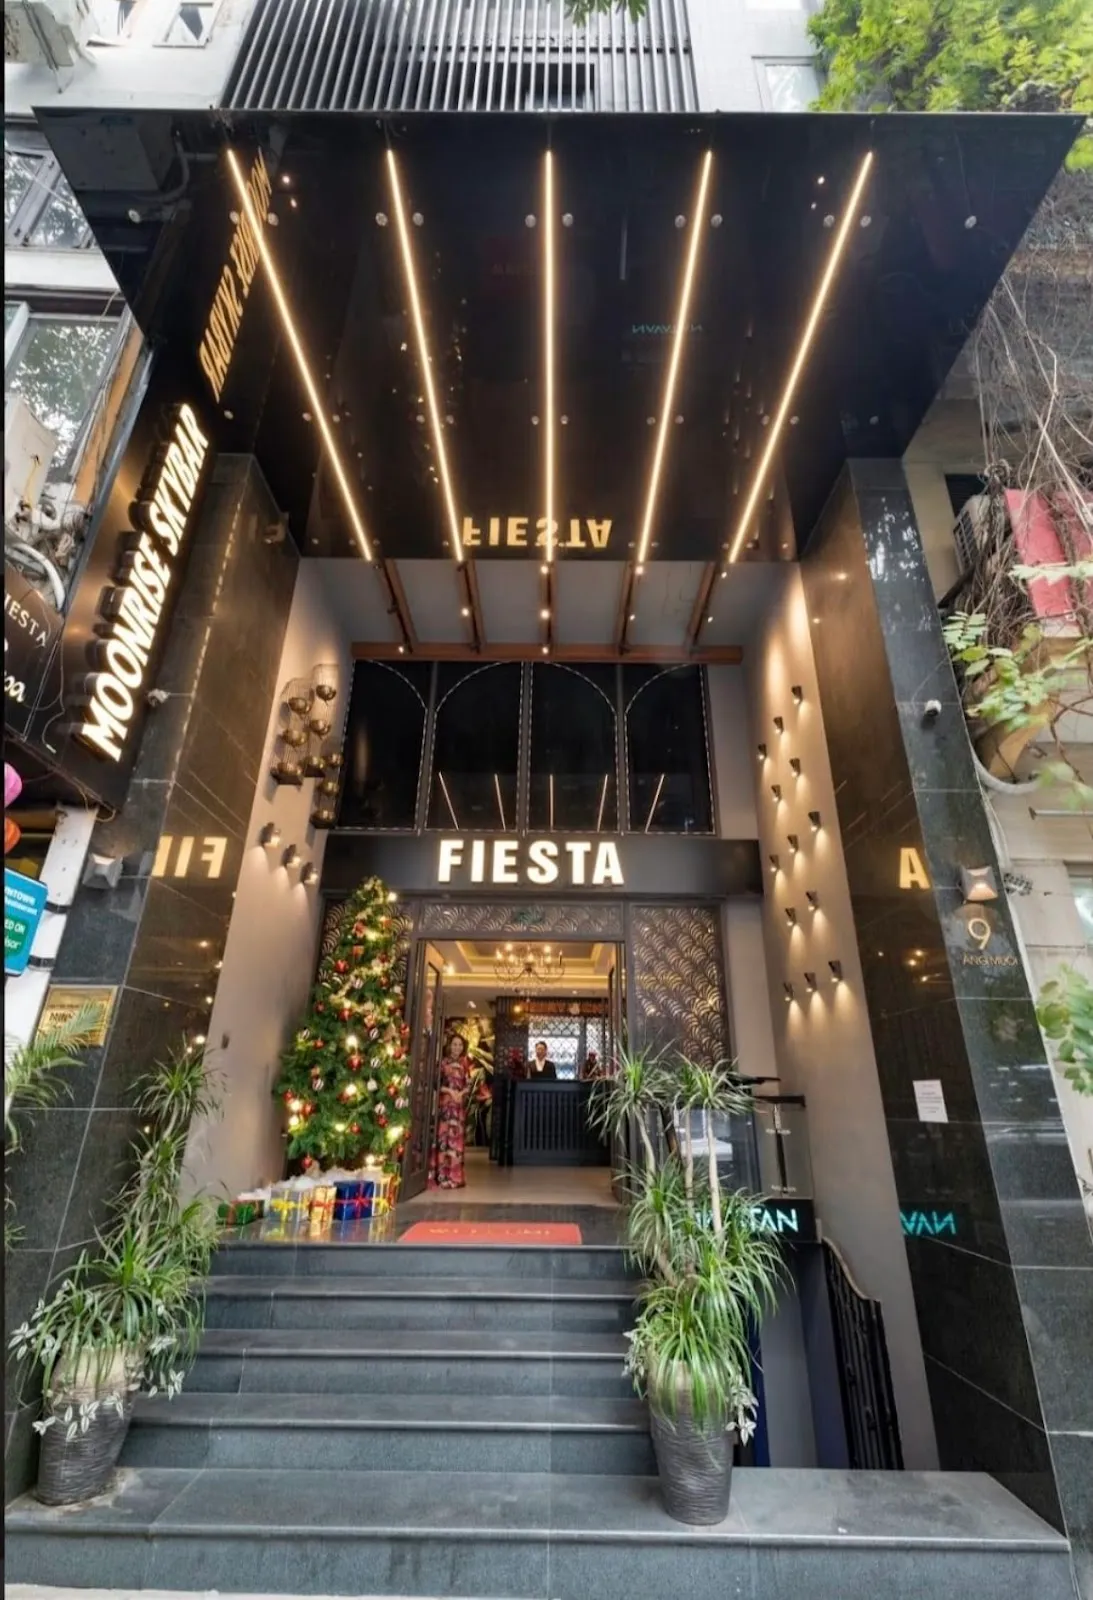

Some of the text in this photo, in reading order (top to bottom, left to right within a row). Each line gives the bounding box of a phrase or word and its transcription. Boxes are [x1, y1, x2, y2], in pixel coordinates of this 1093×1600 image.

[82, 403, 209, 763] MOONRISE SKYBAR
[437, 838, 625, 885] FIESTA
[968, 918, 991, 949] 9
